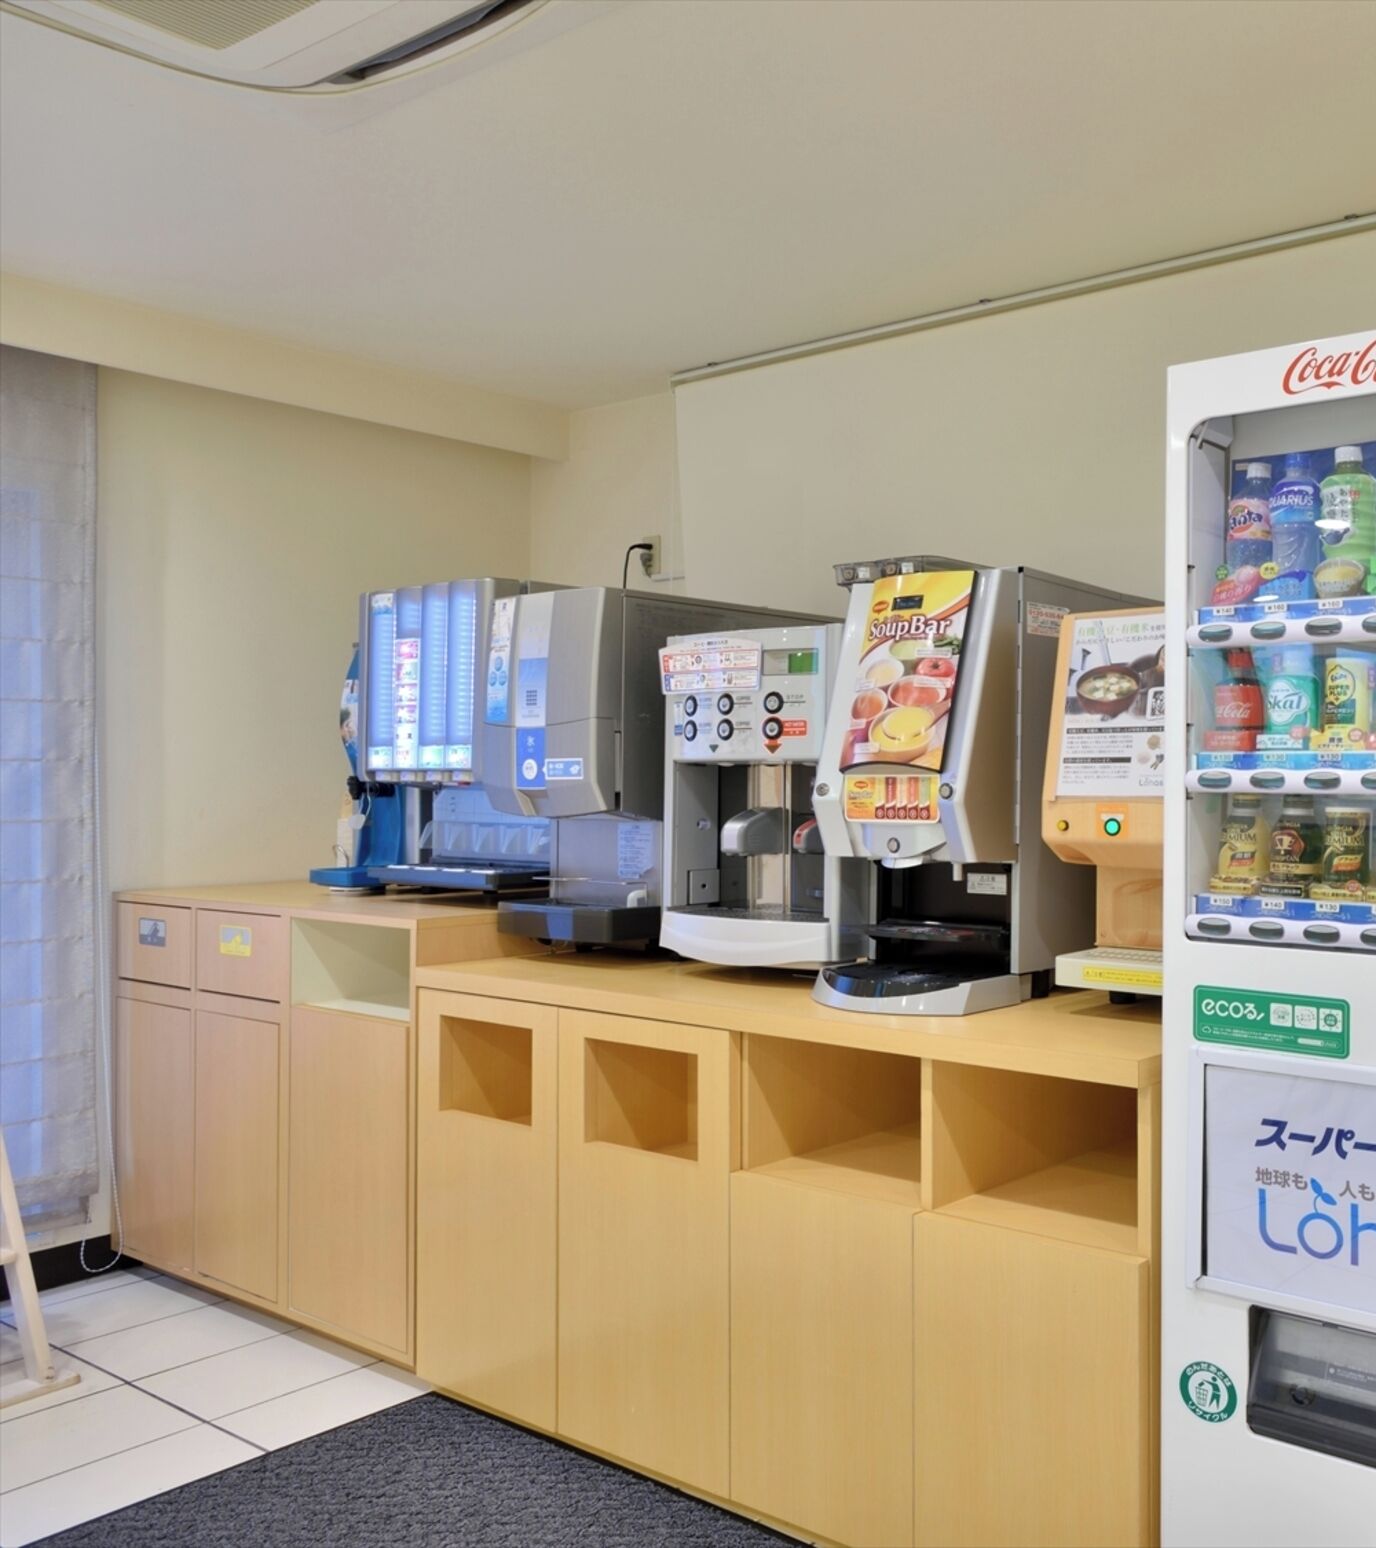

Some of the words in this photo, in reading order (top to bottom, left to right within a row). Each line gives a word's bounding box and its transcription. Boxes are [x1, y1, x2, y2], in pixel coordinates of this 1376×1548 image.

[1268, 494, 1314, 508] UARIUS
[1228, 510, 1264, 531] anta
[1255, 1166, 1309, 1191] 地球も
